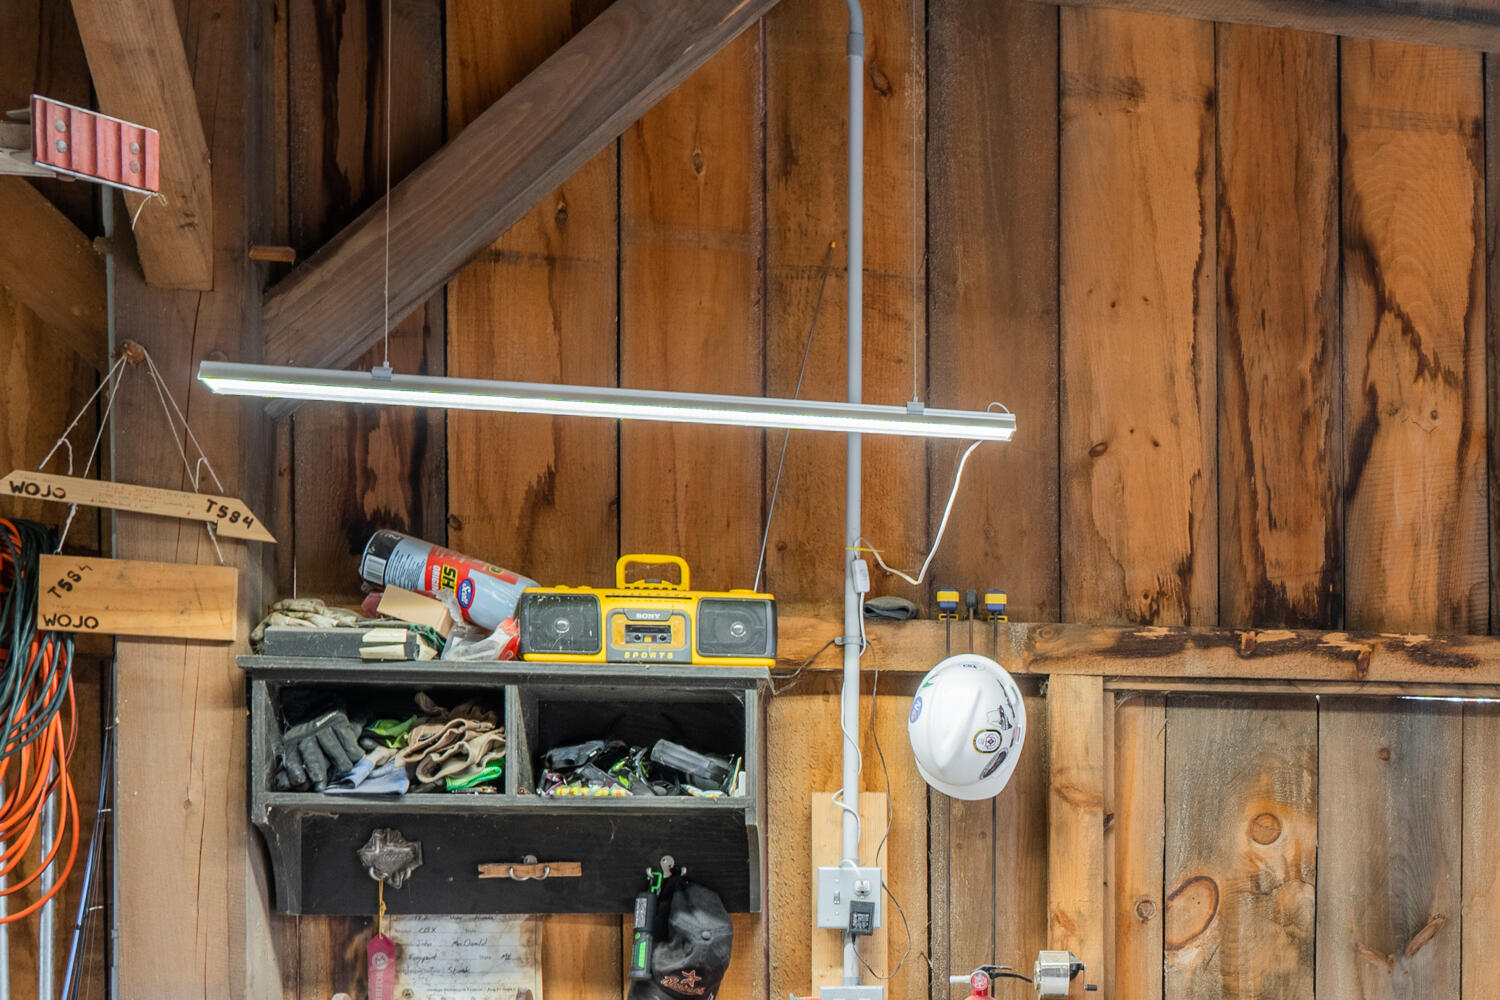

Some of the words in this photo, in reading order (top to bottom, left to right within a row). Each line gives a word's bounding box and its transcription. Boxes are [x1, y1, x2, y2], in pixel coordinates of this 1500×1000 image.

[9, 480, 67, 500] WOJO
[42, 613, 99, 630] WOJO
[635, 612, 661, 620] SONY
[623, 651, 675, 660] SPORTS
